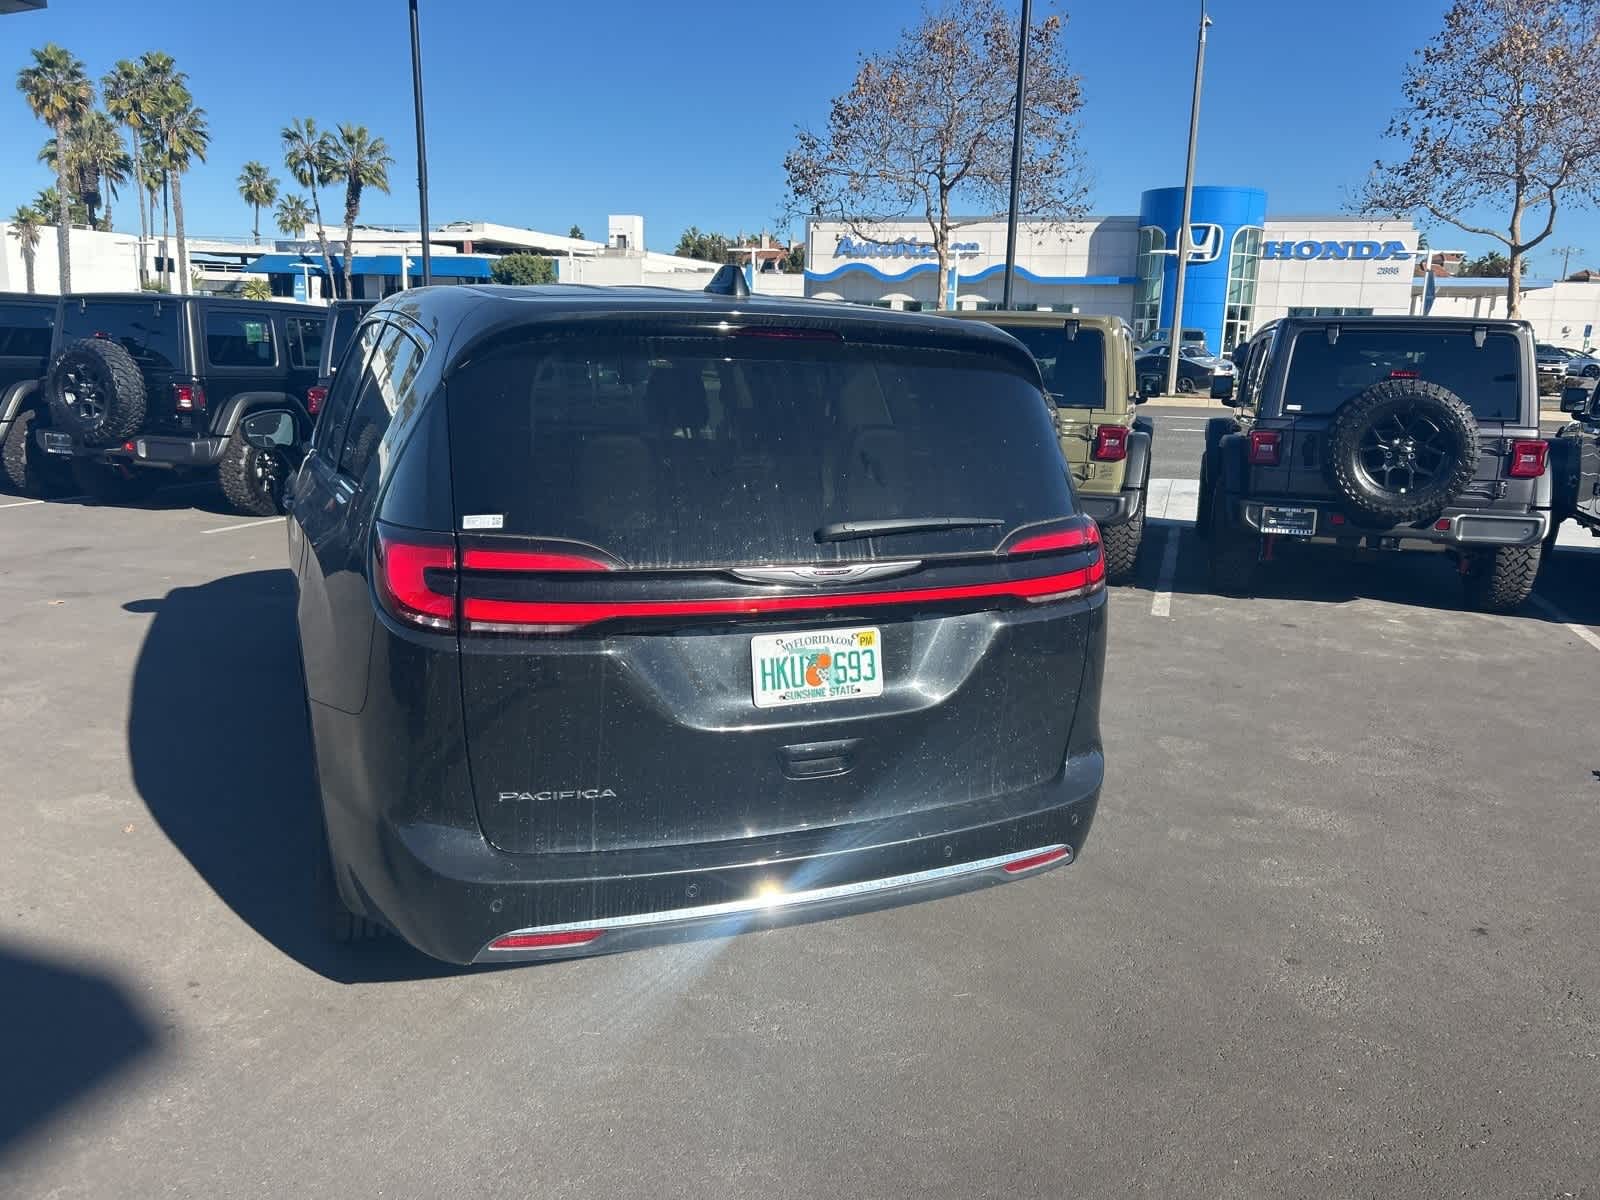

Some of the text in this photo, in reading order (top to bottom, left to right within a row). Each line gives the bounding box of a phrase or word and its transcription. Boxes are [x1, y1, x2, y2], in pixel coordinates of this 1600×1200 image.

[833, 235, 979, 259] AutoNaon
[1261, 240, 1412, 260] HONDA
[760, 655, 805, 691] HKU
[784, 684, 856, 700] SUNSHINE STATE
[499, 788, 617, 801] PACIFICA
